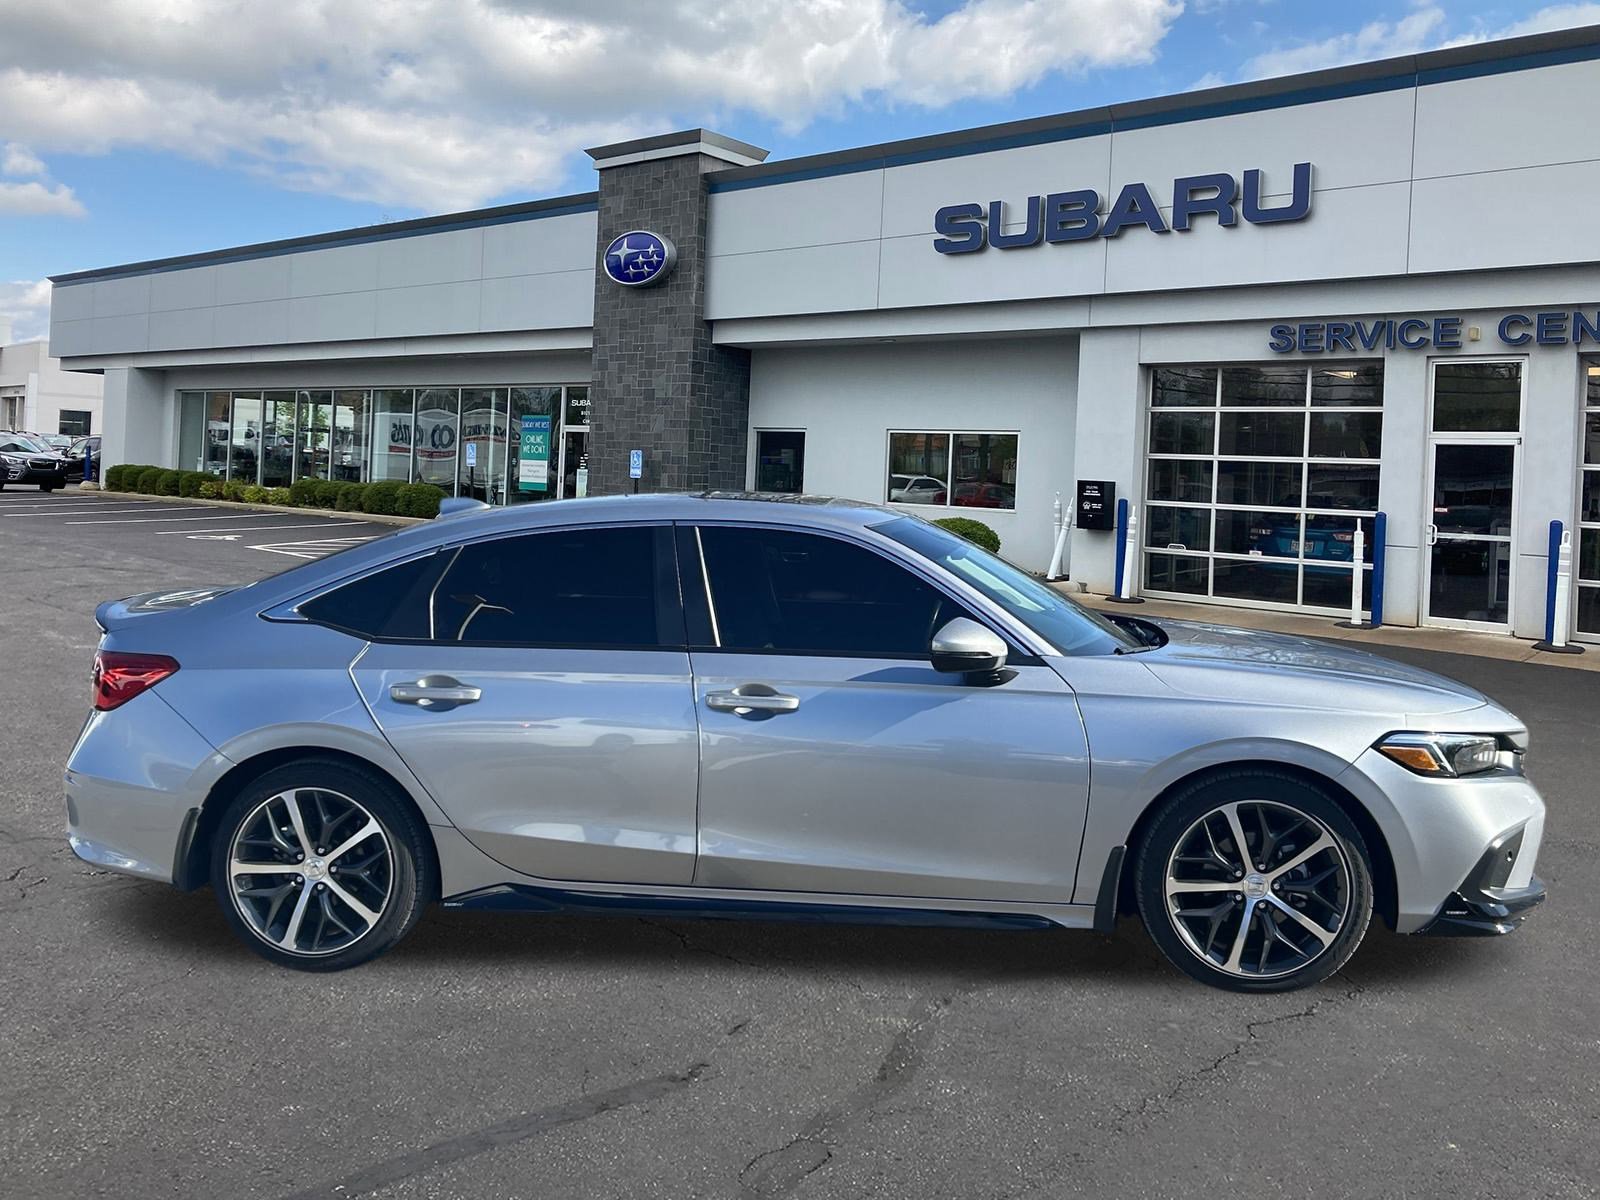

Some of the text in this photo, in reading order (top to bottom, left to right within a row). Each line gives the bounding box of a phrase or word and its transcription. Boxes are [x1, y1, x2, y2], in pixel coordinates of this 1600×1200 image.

[934, 162, 1312, 254] SUBARU
[1269, 311, 1600, 353] SERVICE CEN
